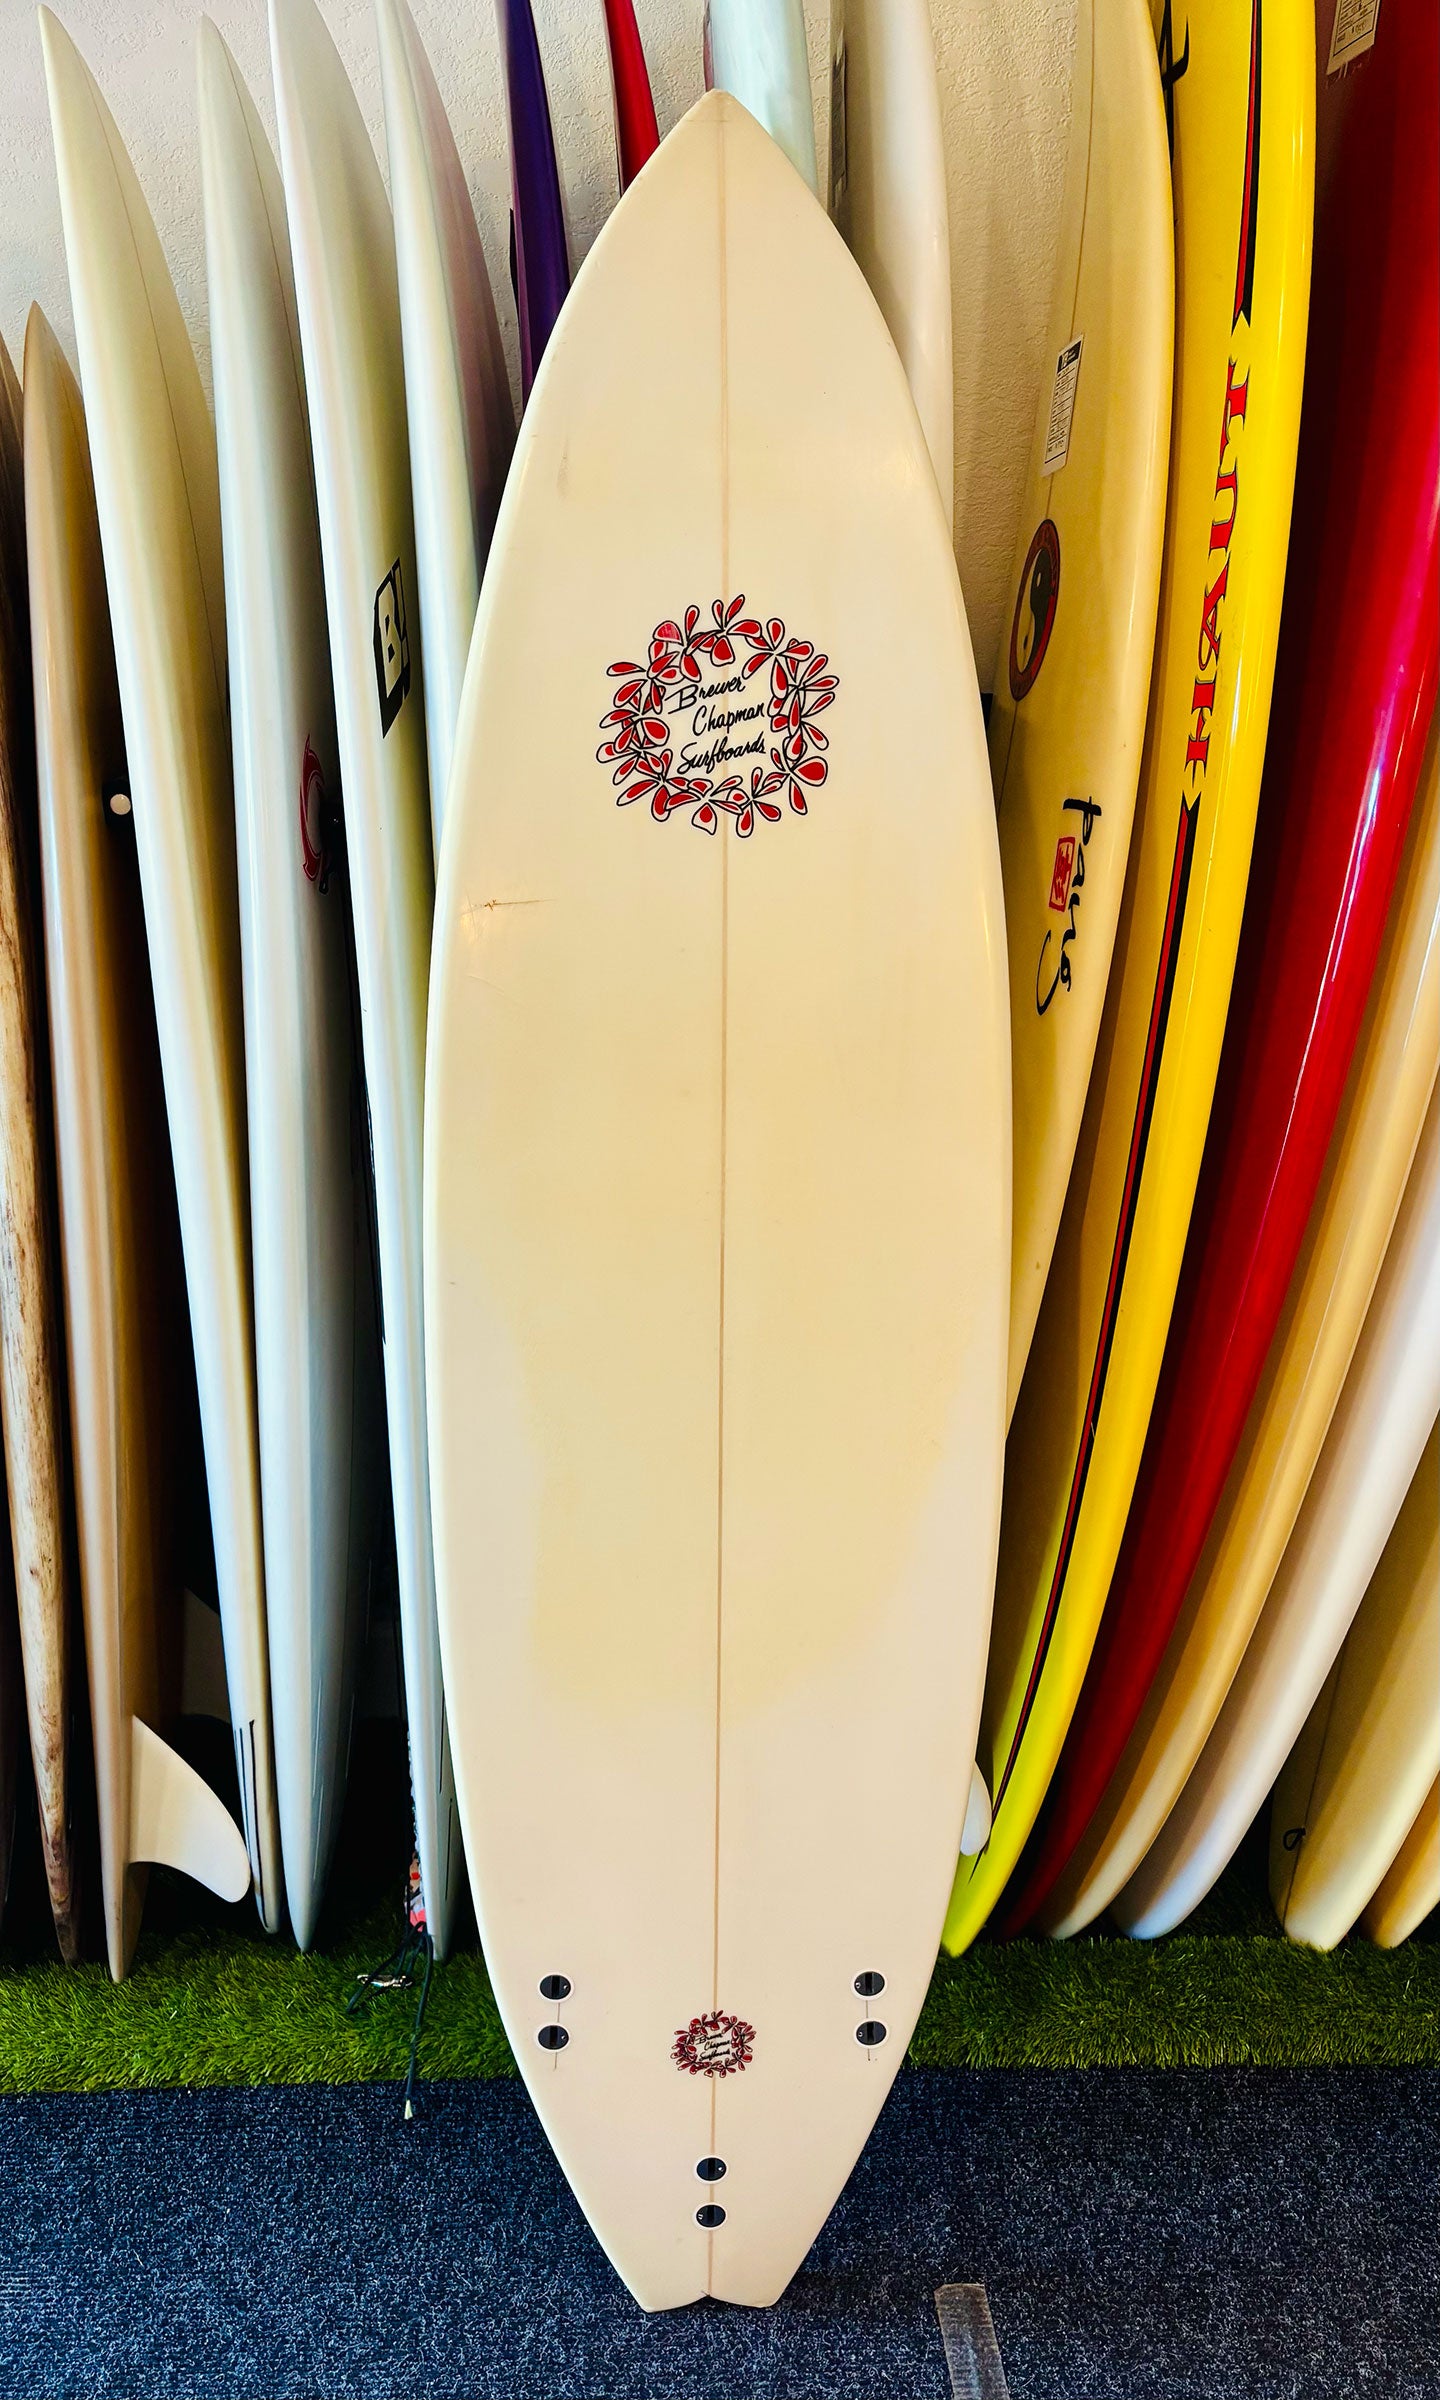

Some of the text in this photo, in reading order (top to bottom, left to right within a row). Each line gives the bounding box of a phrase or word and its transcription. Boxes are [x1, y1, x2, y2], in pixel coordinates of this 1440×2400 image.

[1182, 355, 1250, 788] HAUT
[664, 676, 746, 714] Brewer
[692, 702, 766, 737] Chapman
[677, 731, 767, 774] Surfboards
